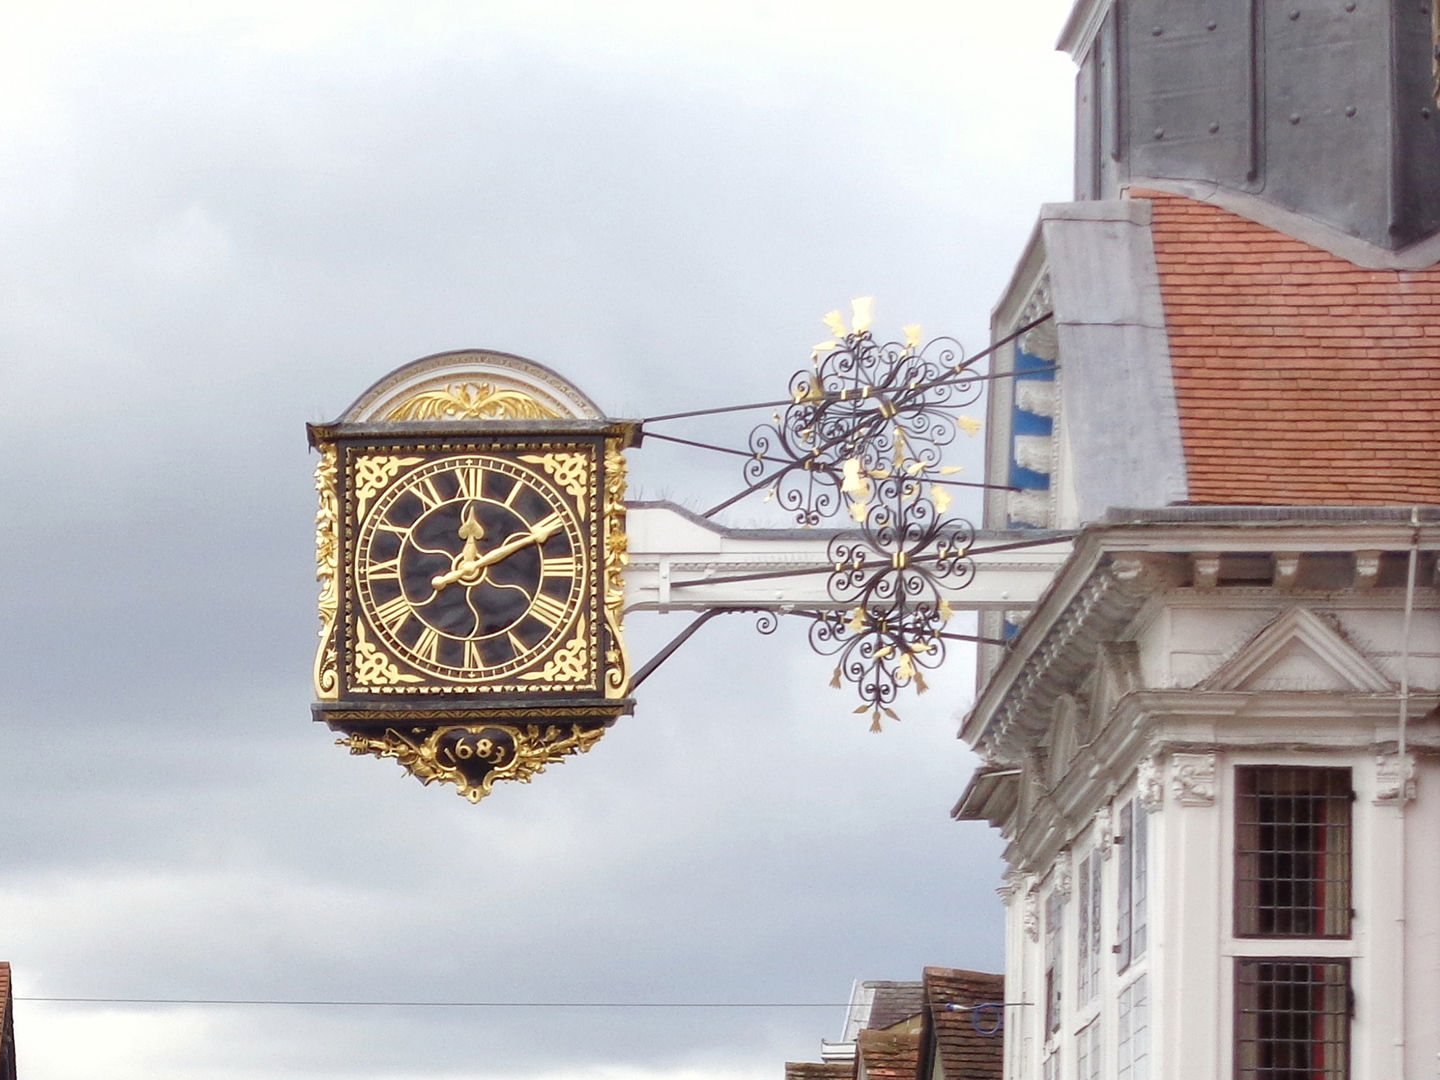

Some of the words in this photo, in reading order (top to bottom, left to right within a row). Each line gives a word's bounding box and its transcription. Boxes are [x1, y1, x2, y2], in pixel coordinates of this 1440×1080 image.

[407, 477, 442, 514] XI
[456, 468, 483, 499] XII
[505, 479, 524, 508] I
[542, 557, 575, 577] III
[443, 737, 505, 765] 1683
